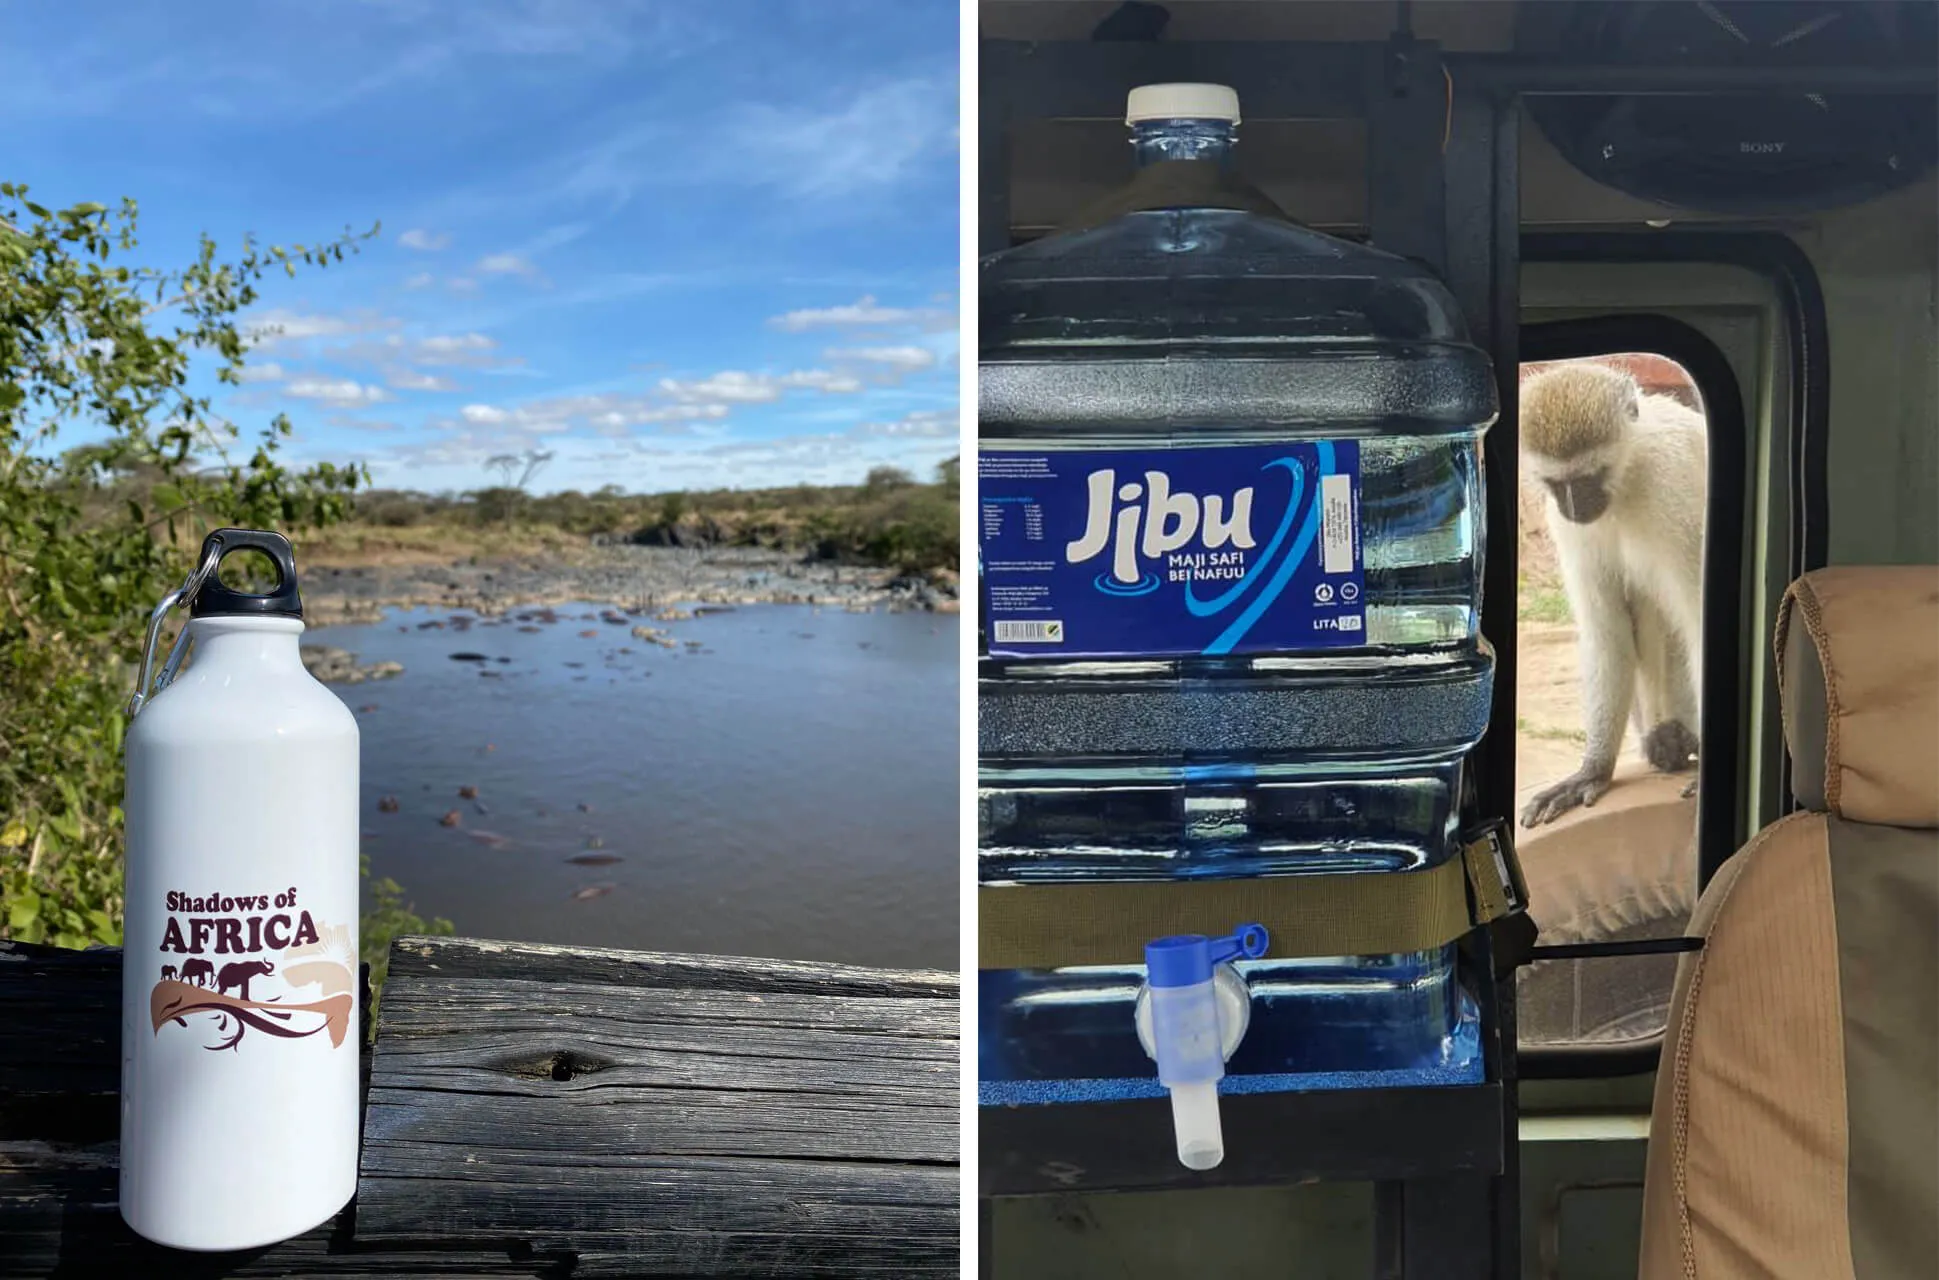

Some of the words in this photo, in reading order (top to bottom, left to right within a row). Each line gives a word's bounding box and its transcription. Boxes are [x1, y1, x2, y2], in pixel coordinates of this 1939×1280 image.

[1740, 142, 1784, 153] SONY
[1066, 469, 1256, 584] Jibu
[1168, 553, 1206, 569] MAJI
[1209, 551, 1244, 566] SAFI
[1168, 568, 1190, 582] BEI
[1193, 567, 1245, 580] NAFUU
[1313, 618, 1338, 630] LITA
[166, 891, 269, 912] Shadows
[274, 886, 298, 909] of
[159, 910, 320, 955] AFRICA
